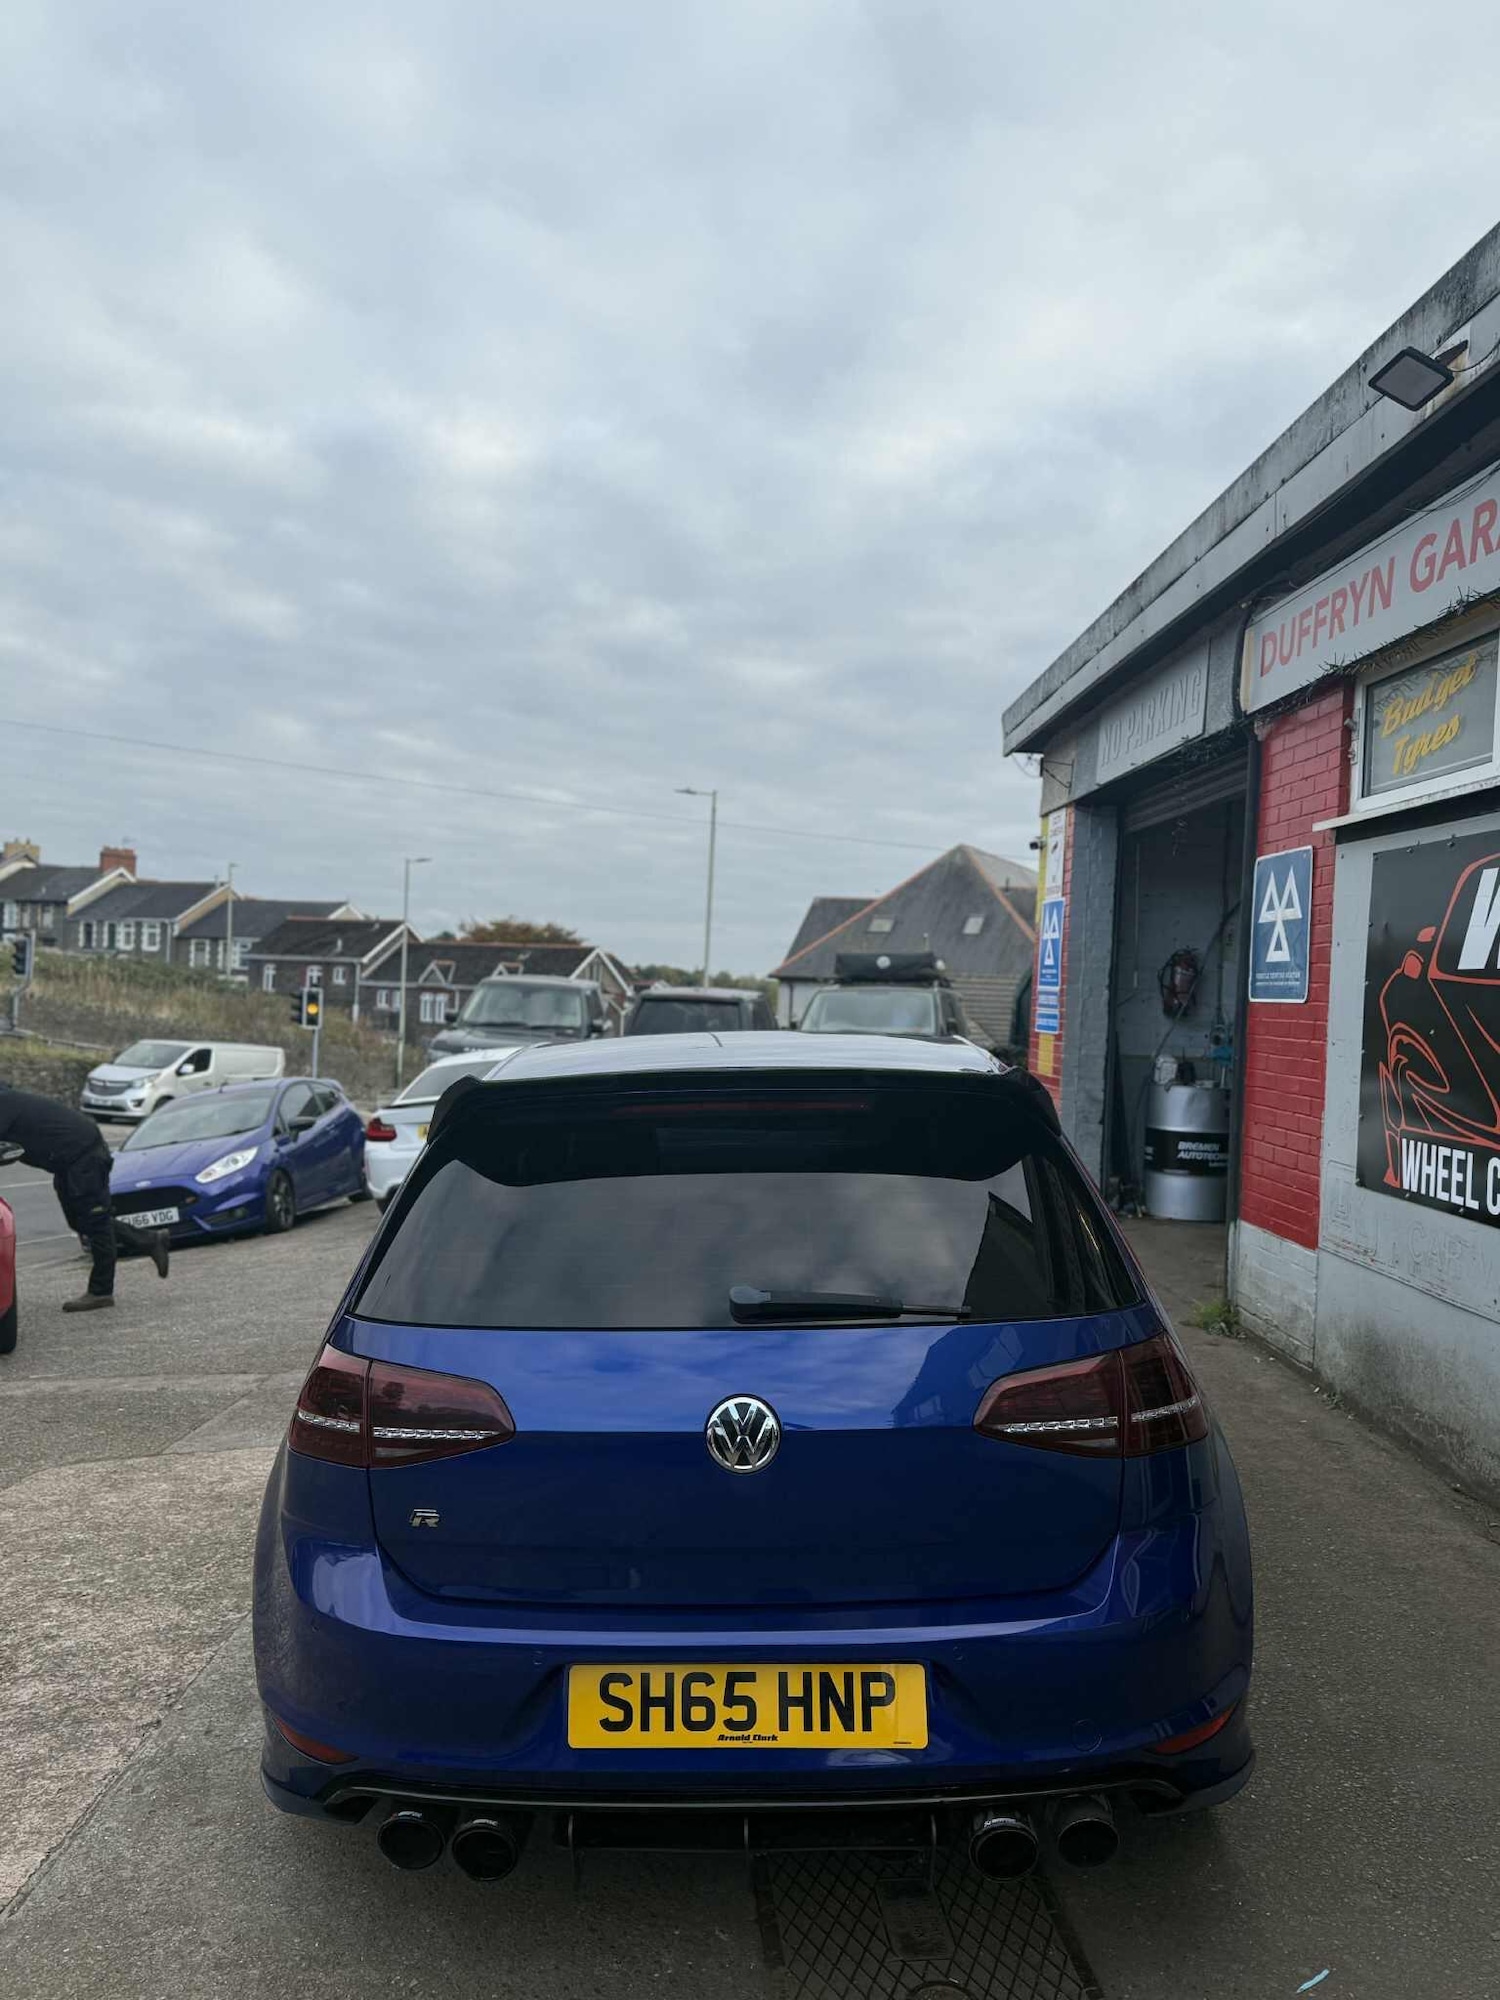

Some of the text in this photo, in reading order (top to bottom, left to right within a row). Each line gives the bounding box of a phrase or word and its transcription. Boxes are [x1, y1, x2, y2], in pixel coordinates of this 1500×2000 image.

[1260, 499, 1500, 677] DUFFRYN GAR
[1123, 666, 1202, 754] PARKING
[1381, 651, 1477, 738] Budget
[1393, 714, 1461, 775] Tyres
[1178, 1141, 1220, 1151] BREMEN
[1401, 1137, 1480, 1211] WHEEL
[599, 1671, 896, 1732] SH65 HNP
